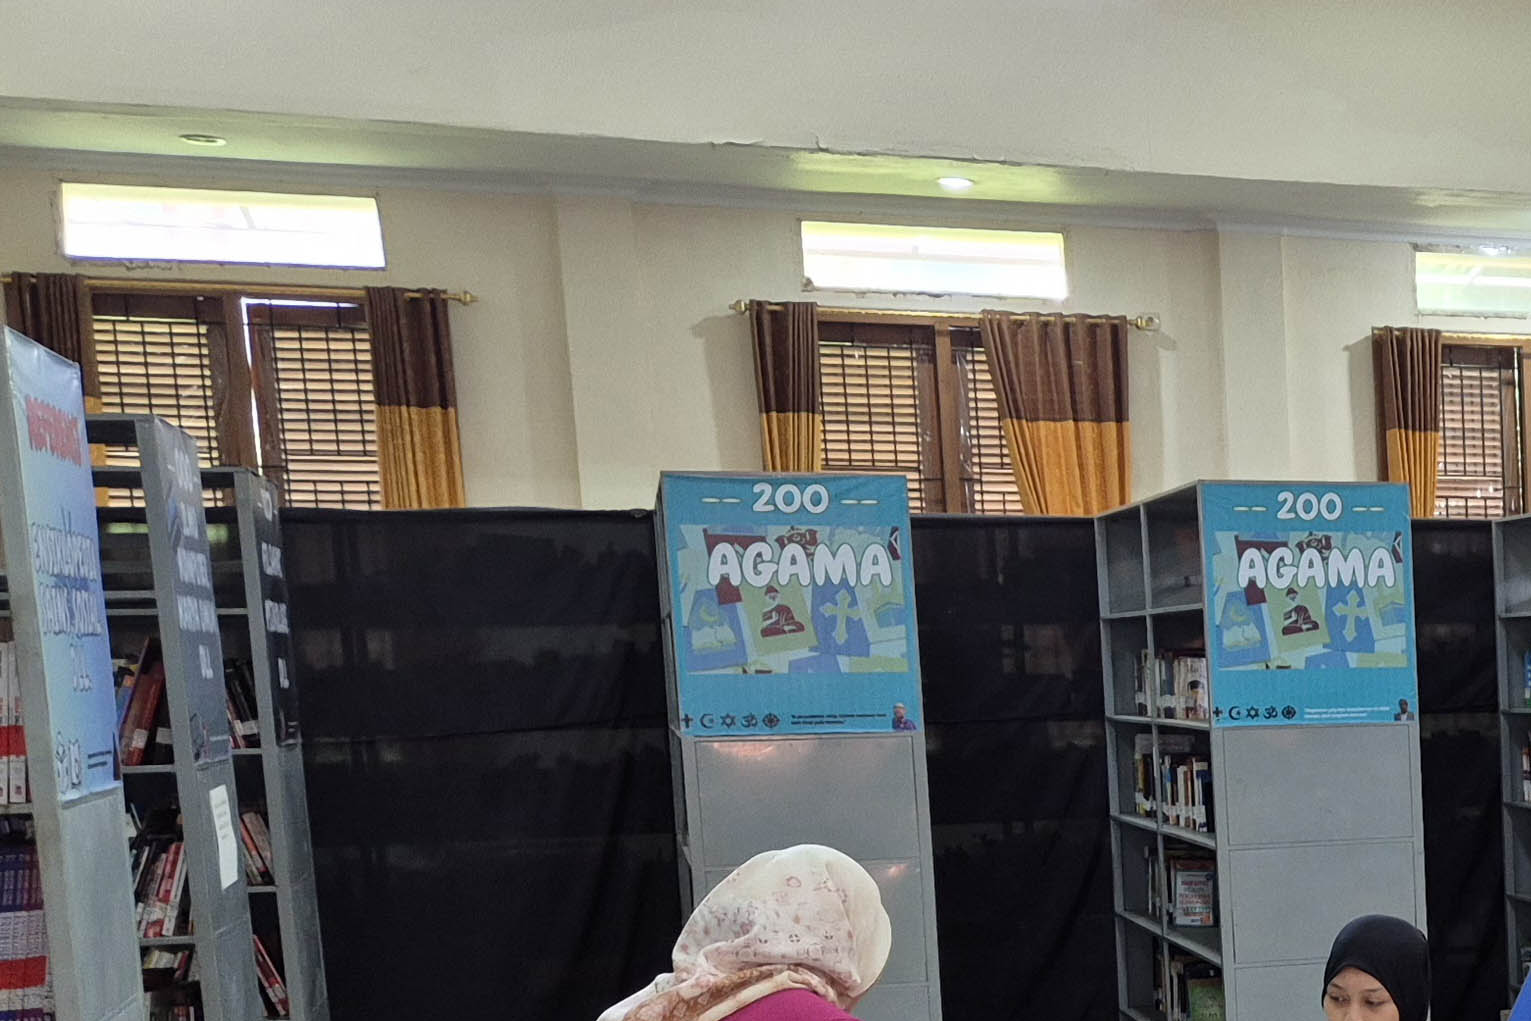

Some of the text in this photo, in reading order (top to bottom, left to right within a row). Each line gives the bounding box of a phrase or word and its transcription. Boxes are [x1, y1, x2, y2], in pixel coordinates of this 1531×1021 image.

[752, 482, 829, 514] 200
[1277, 491, 1343, 520] 200
[707, 543, 893, 587] AGAMA
[1237, 547, 1395, 589] AGAMA
